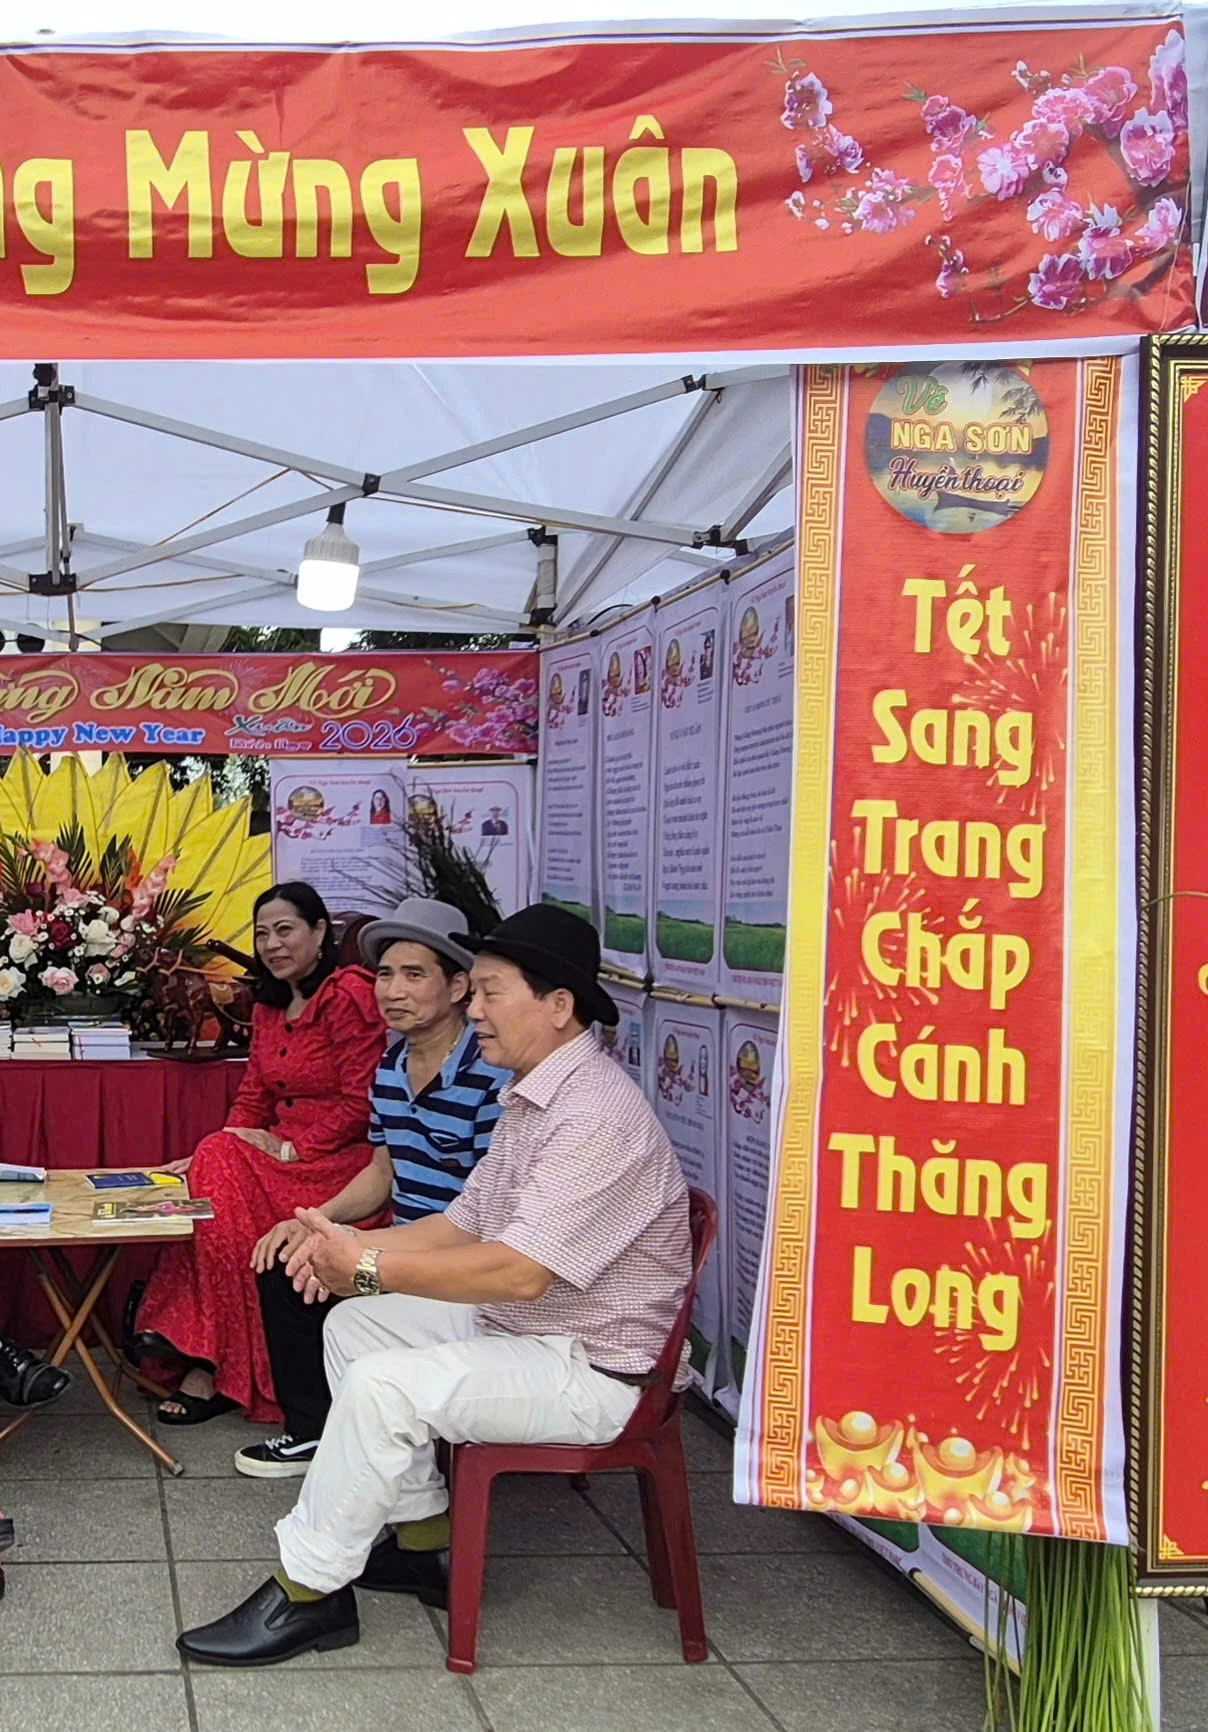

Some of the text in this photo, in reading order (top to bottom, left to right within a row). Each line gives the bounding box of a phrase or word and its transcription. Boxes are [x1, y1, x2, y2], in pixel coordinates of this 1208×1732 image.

[125, 130, 422, 294] Mừng
[462, 114, 739, 258] Xuân
[892, 419, 1032, 455] NGA SƠN
[896, 375, 949, 416] Về
[902, 564, 1011, 657] Tết
[74, 722, 134, 745] New
[141, 721, 206, 745] Year
[90, 662, 240, 712] Năm
[247, 660, 397, 718] Mới
[320, 713, 417, 750] 2026
[873, 689, 1035, 785] Sang
[853, 800, 1045, 899] Trang
[862, 909, 1031, 1011] Chắp
[857, 1019, 1026, 1107] Cánh
[828, 1134, 1048, 1238] Thăng
[851, 1247, 1019, 1351] Long
